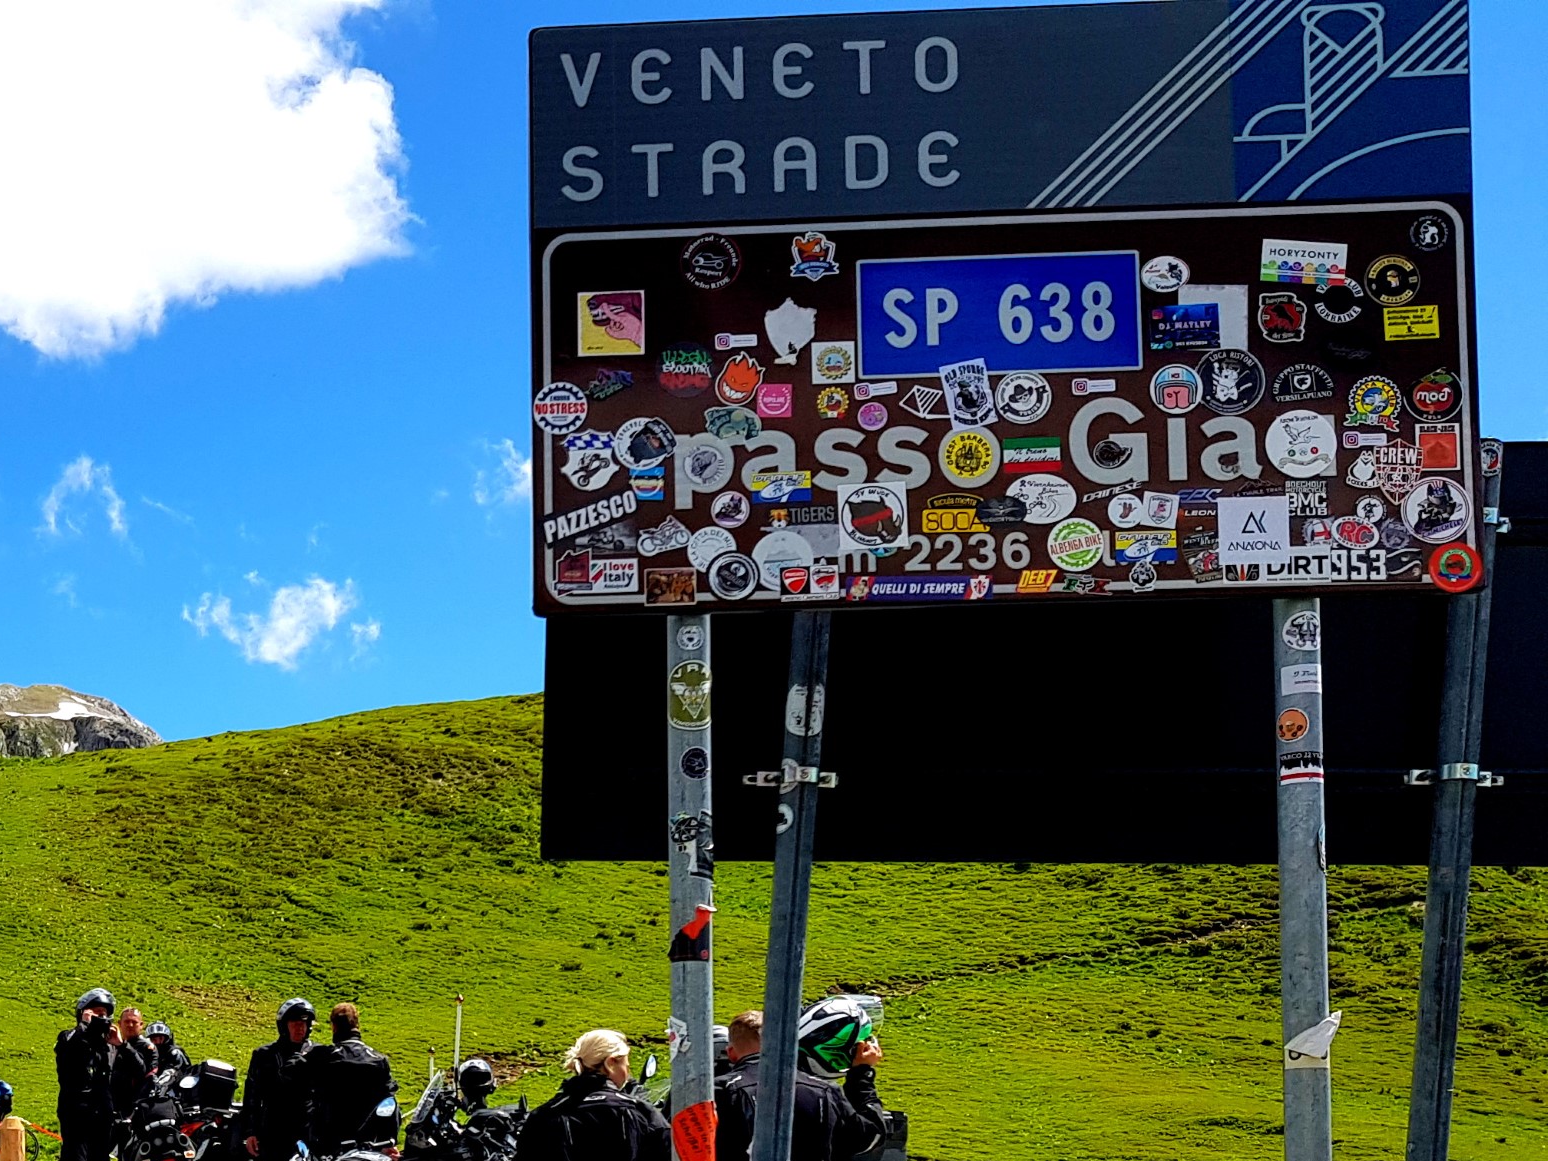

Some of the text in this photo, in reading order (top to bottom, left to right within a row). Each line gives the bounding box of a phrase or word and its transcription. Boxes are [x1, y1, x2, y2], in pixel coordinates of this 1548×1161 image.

[559, 36, 959, 108] VENETO
[560, 131, 961, 202] STRADE
[1269, 248, 1339, 260] HORYZONTY
[883, 281, 1116, 349] SP 638
[1316, 304, 1360, 322] LORRAINE
[1209, 351, 1255, 368] LUCA RISTORI
[1273, 366, 1295, 395] GRUPPO
[1274, 390, 1333, 403] VERSILAPUANO
[1355, 382, 1377, 403] VESPA
[535, 402, 586, 415] NO STRESS
[1068, 396, 1338, 484] Gia
[1380, 447, 1418, 465] CREW
[1082, 481, 1143, 503] DAINESE
[1286, 492, 1327, 508] BMC
[543, 490, 637, 544] PAZZESCO
[788, 505, 835, 524] TIGERS
[1288, 507, 1328, 516] CLUB
[903, 531, 1031, 574] 2236
[1050, 538, 1084, 556] ALBENGA
[1084, 533, 1103, 548] BIKE
[609, 562, 634, 571] love
[603, 571, 635, 587] Italy
[871, 582, 965, 595] QUELLI DI SEMPRE
